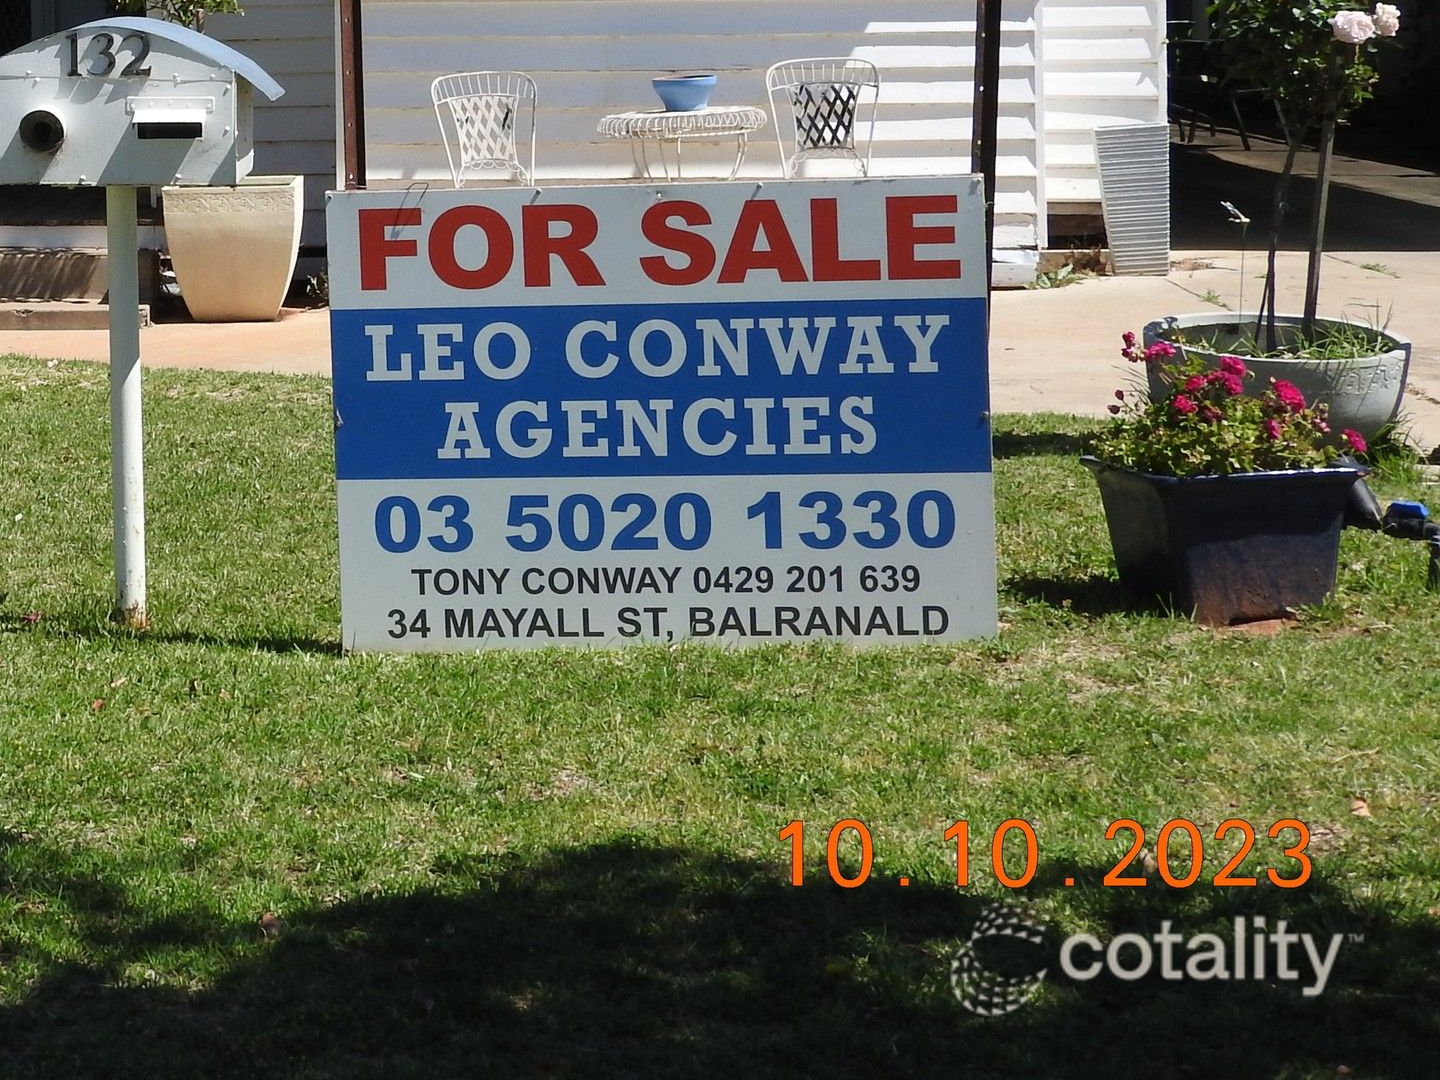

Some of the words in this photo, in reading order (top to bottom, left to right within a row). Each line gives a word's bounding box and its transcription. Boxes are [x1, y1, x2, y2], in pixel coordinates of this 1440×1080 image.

[64, 32, 152, 77] 132
[358, 204, 606, 290] FOR
[639, 195, 961, 285] SALE
[364, 321, 531, 382] LEO
[565, 314, 950, 379] CONWAY
[437, 395, 877, 459] AGENCIES
[374, 494, 474, 553] 03
[506, 492, 712, 551] 5020
[747, 489, 956, 549] 1330
[411, 567, 510, 596] TONY
[521, 566, 682, 595] CONWAY
[692, 565, 774, 594] 0429
[785, 565, 845, 593] 201
[859, 564, 921, 593] 639
[387, 609, 431, 639] 34
[443, 607, 605, 638] MAYALL
[617, 606, 676, 643] ST,
[693, 605, 950, 637] BALRANALD
